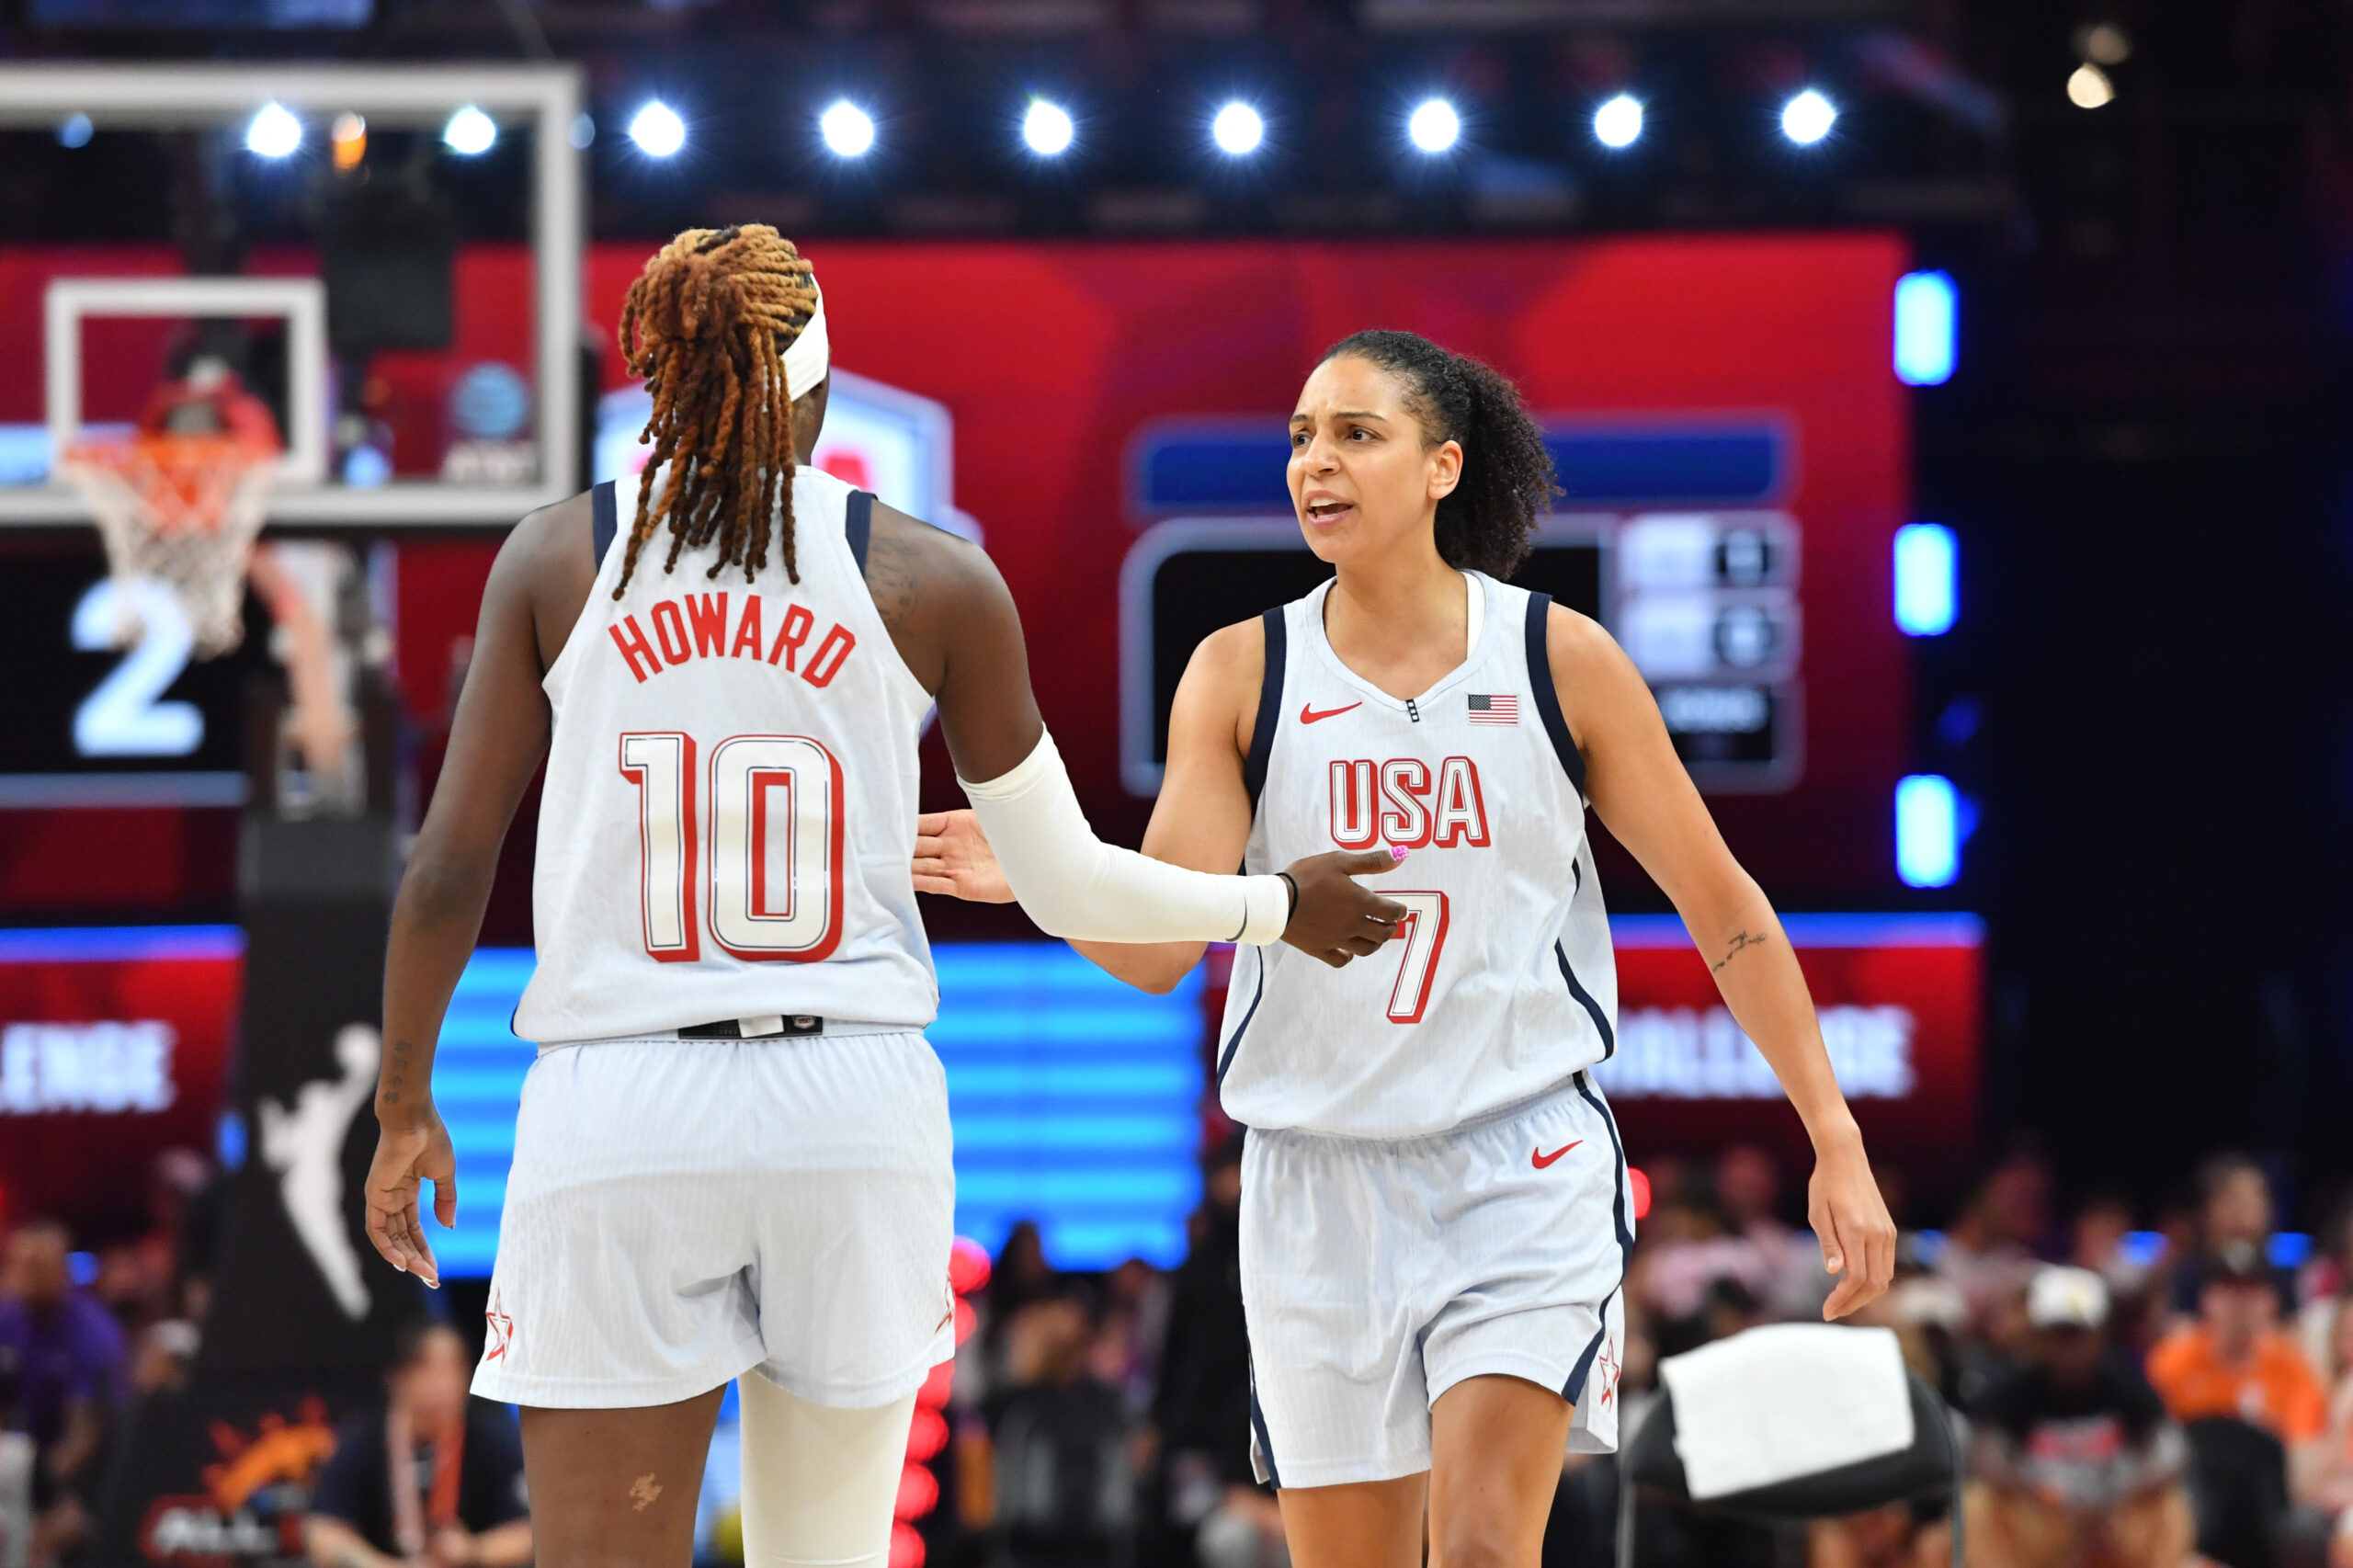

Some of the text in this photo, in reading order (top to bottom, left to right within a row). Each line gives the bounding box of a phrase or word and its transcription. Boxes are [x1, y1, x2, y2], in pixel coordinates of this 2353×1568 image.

[70, 575, 205, 756] 2
[608, 592, 856, 687] HOWARD
[620, 732, 844, 962] 10
[1330, 756, 1491, 849] USA
[1367, 890, 1449, 1024] 7
[0, 1021, 177, 1114] ENGE
